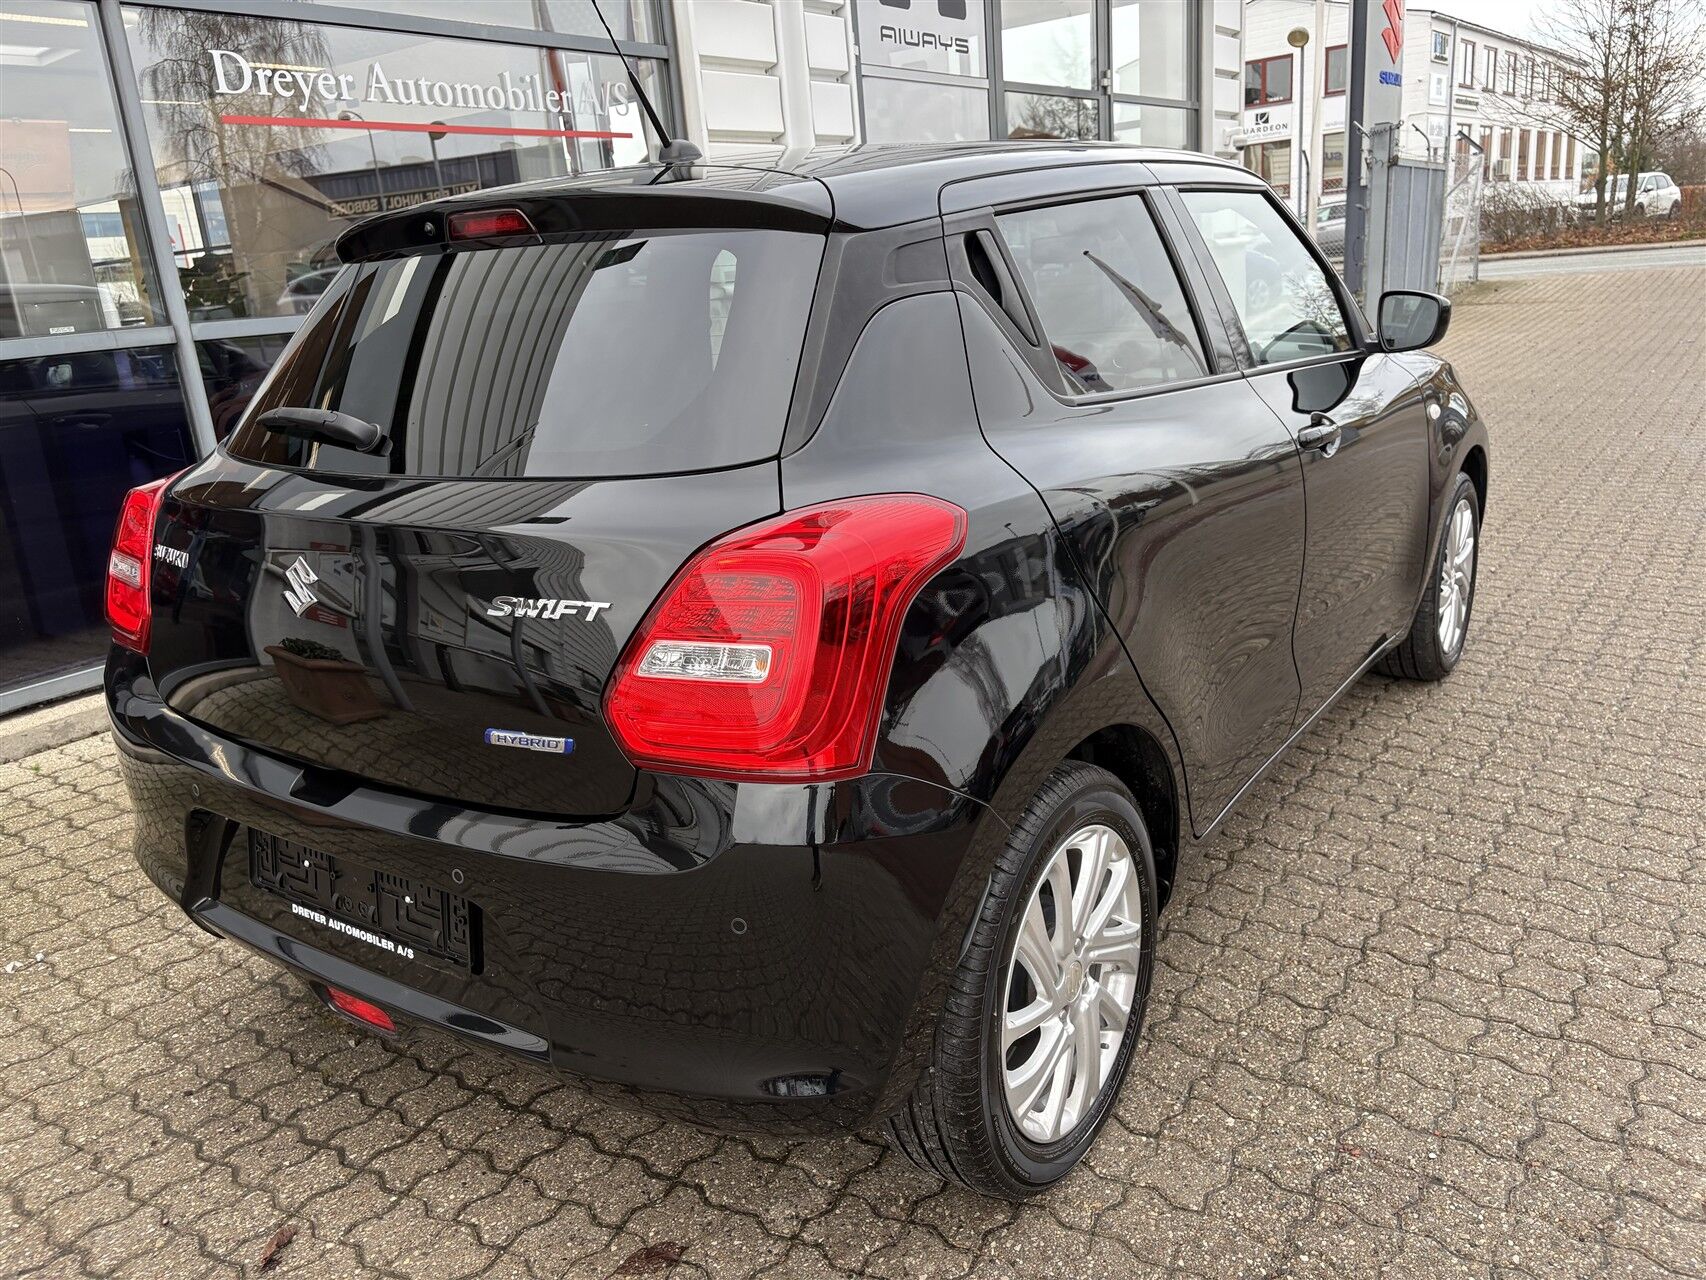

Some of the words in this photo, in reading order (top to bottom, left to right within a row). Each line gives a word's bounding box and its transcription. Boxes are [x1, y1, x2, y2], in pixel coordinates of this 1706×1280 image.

[880, 25, 969, 54] AIWAYS
[208, 50, 354, 112] Dreyer
[367, 61, 572, 113] Automobiler
[580, 80, 629, 116] A/S
[1379, 70, 1402, 87] SUZU
[1243, 122, 1288, 135] UARDEON
[487, 595, 613, 622] SWIFT
[497, 734, 559, 749] HYBRID
[291, 903, 327, 926] DREYER
[328, 918, 395, 953] AUTOMOBILER
[396, 944, 415, 960] A/S
